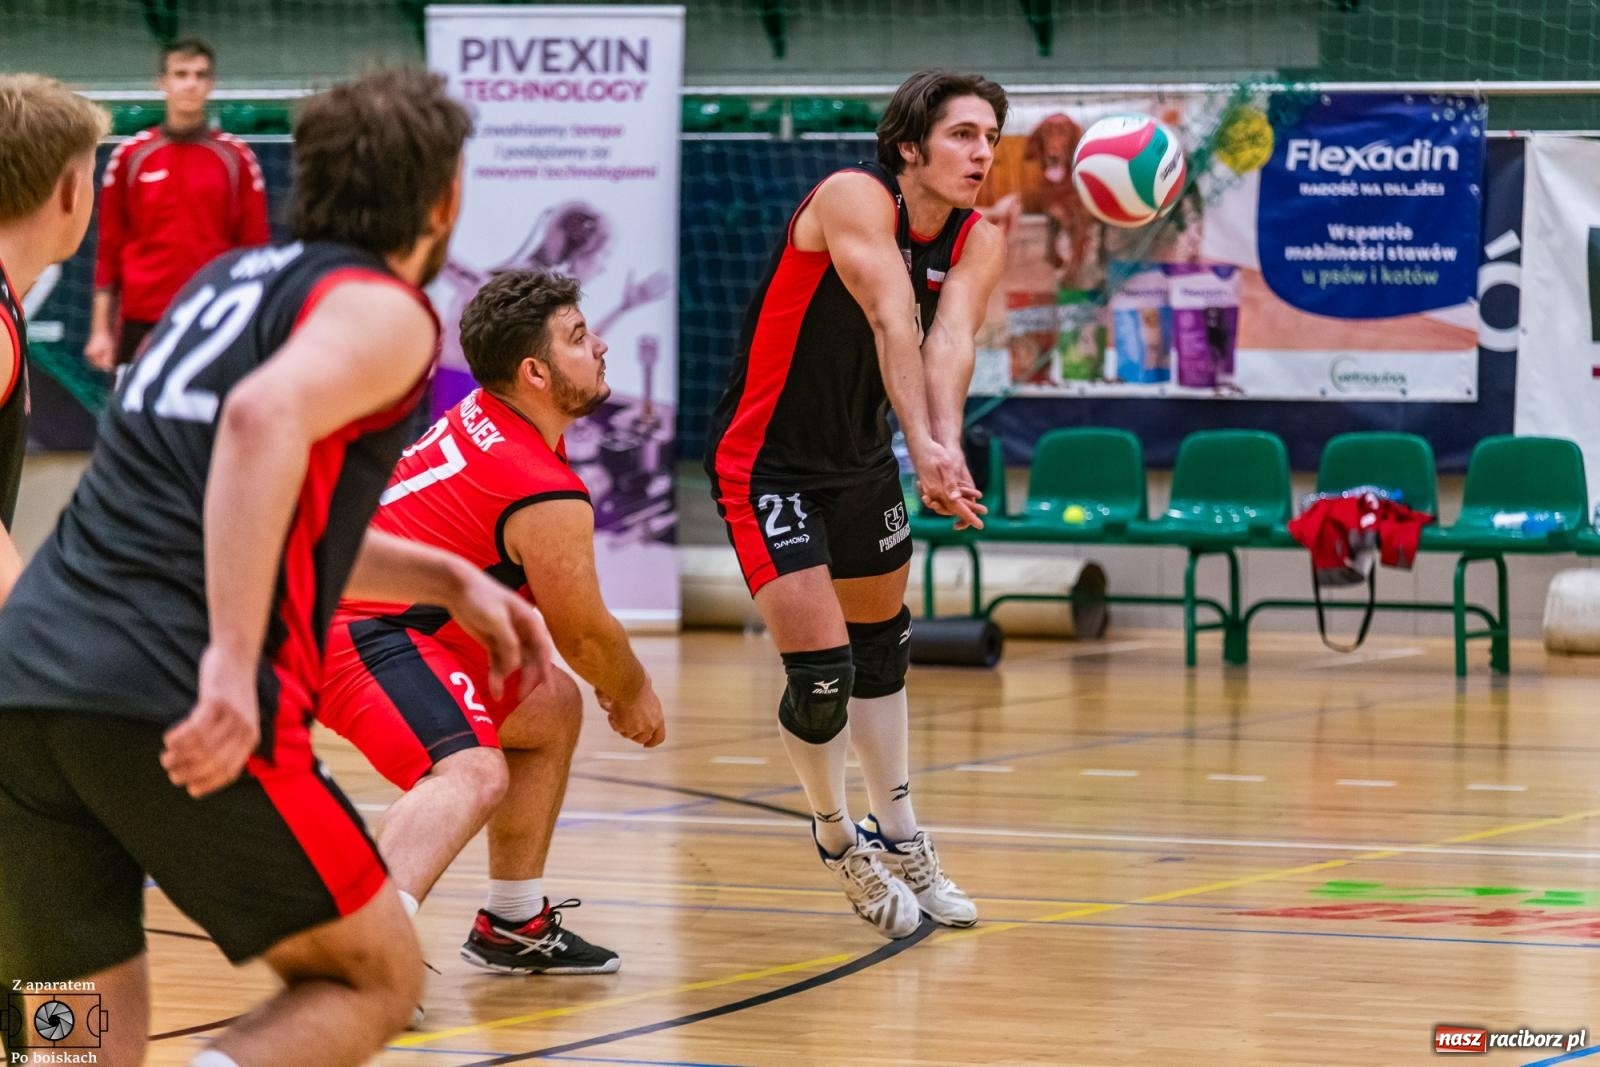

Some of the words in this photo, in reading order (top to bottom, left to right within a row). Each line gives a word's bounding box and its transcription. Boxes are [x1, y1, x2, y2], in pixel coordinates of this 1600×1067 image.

[460, 38, 649, 73] PIVEXIN
[462, 79, 646, 102] TECHNOLOGY
[1285, 138, 1459, 176] Flexadin
[1327, 222, 1414, 246] Wsparcie
[1284, 242, 1384, 261] mobilności
[1387, 242, 1458, 261] stawów
[1302, 269, 1316, 285] u
[1319, 264, 1367, 290] psów
[1370, 265, 1378, 285] i
[1381, 264, 1440, 285] kotów
[122, 281, 264, 424] 12
[450, 671, 486, 712] 2
